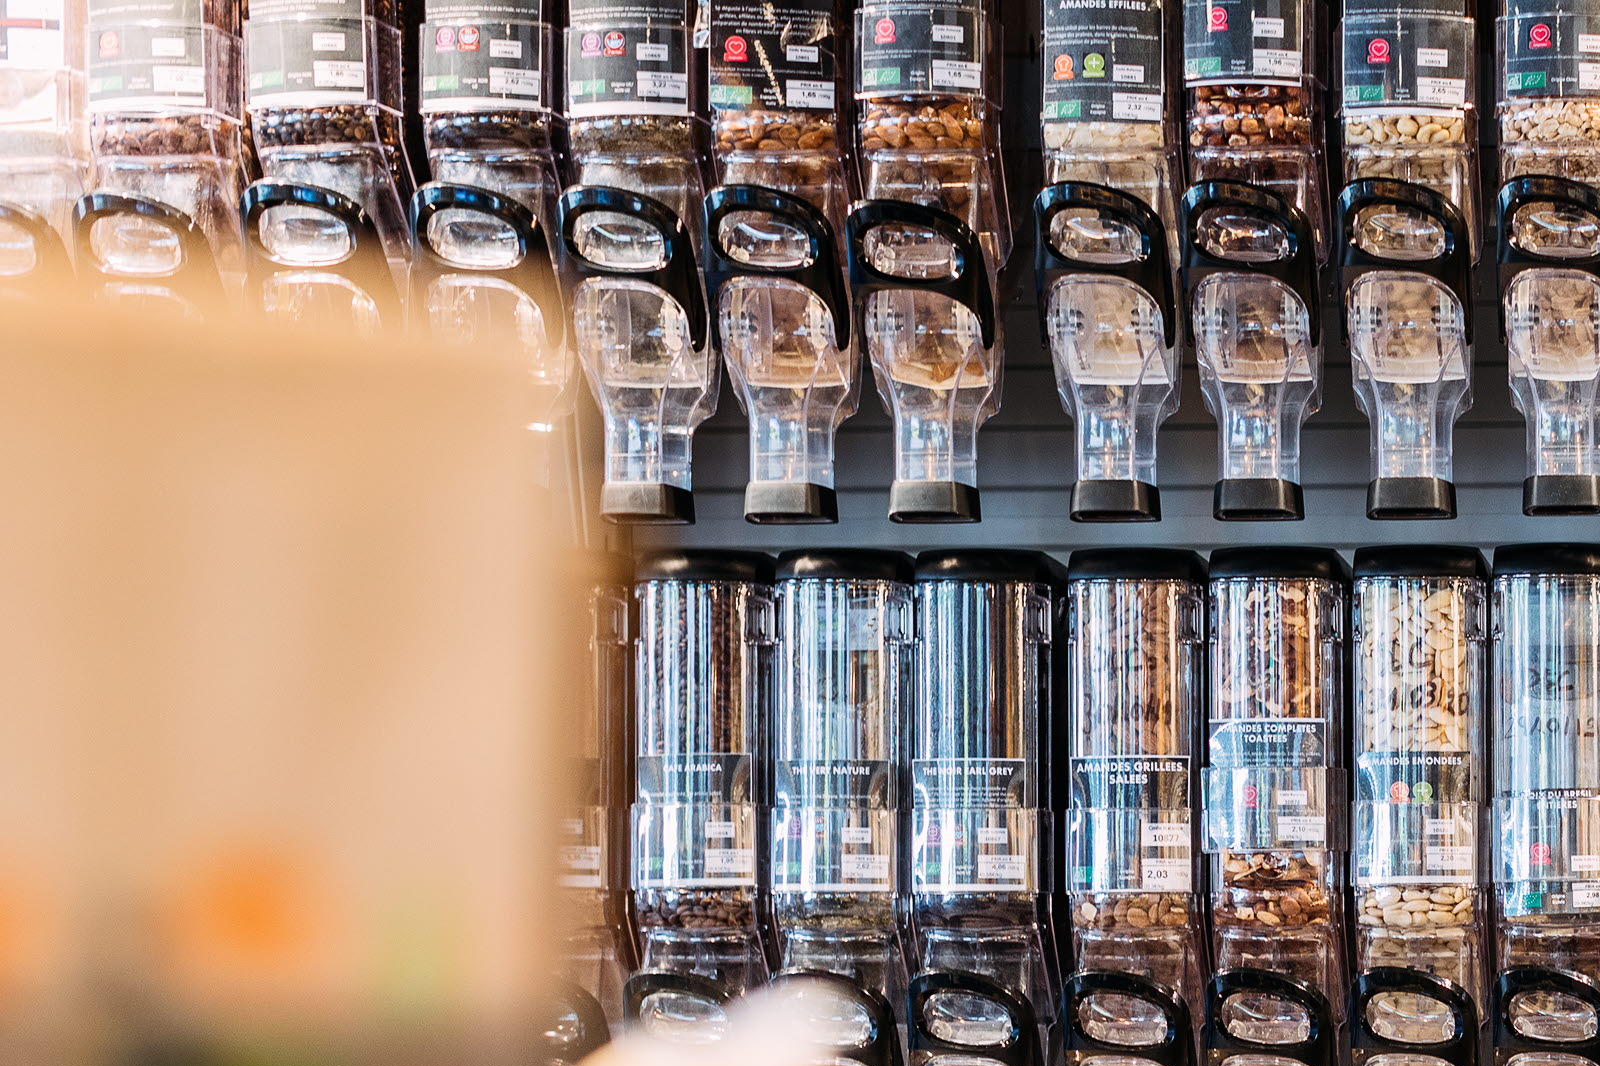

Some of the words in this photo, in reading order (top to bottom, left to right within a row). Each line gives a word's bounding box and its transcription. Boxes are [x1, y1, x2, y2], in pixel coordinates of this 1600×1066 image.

[1060, 0, 1106, 9] AMANDES
[1109, 0, 1147, 11] EFFILEES
[1264, 723, 1317, 733] COMPLETES
[1244, 733, 1288, 743] TOASTEES
[1077, 760, 1132, 773] AMANDES
[1134, 760, 1184, 772] GRILLEES
[1412, 757, 1462, 766] EMONDEES
[684, 763, 722, 772] ARABICA
[833, 766, 870, 776] NATURE
[922, 766, 938, 776] THE
[988, 766, 1014, 776] GREY
[1109, 773, 1149, 785] SALEES
[1564, 789, 1593, 798] BRESIL
[1147, 869, 1169, 880] 2,03
